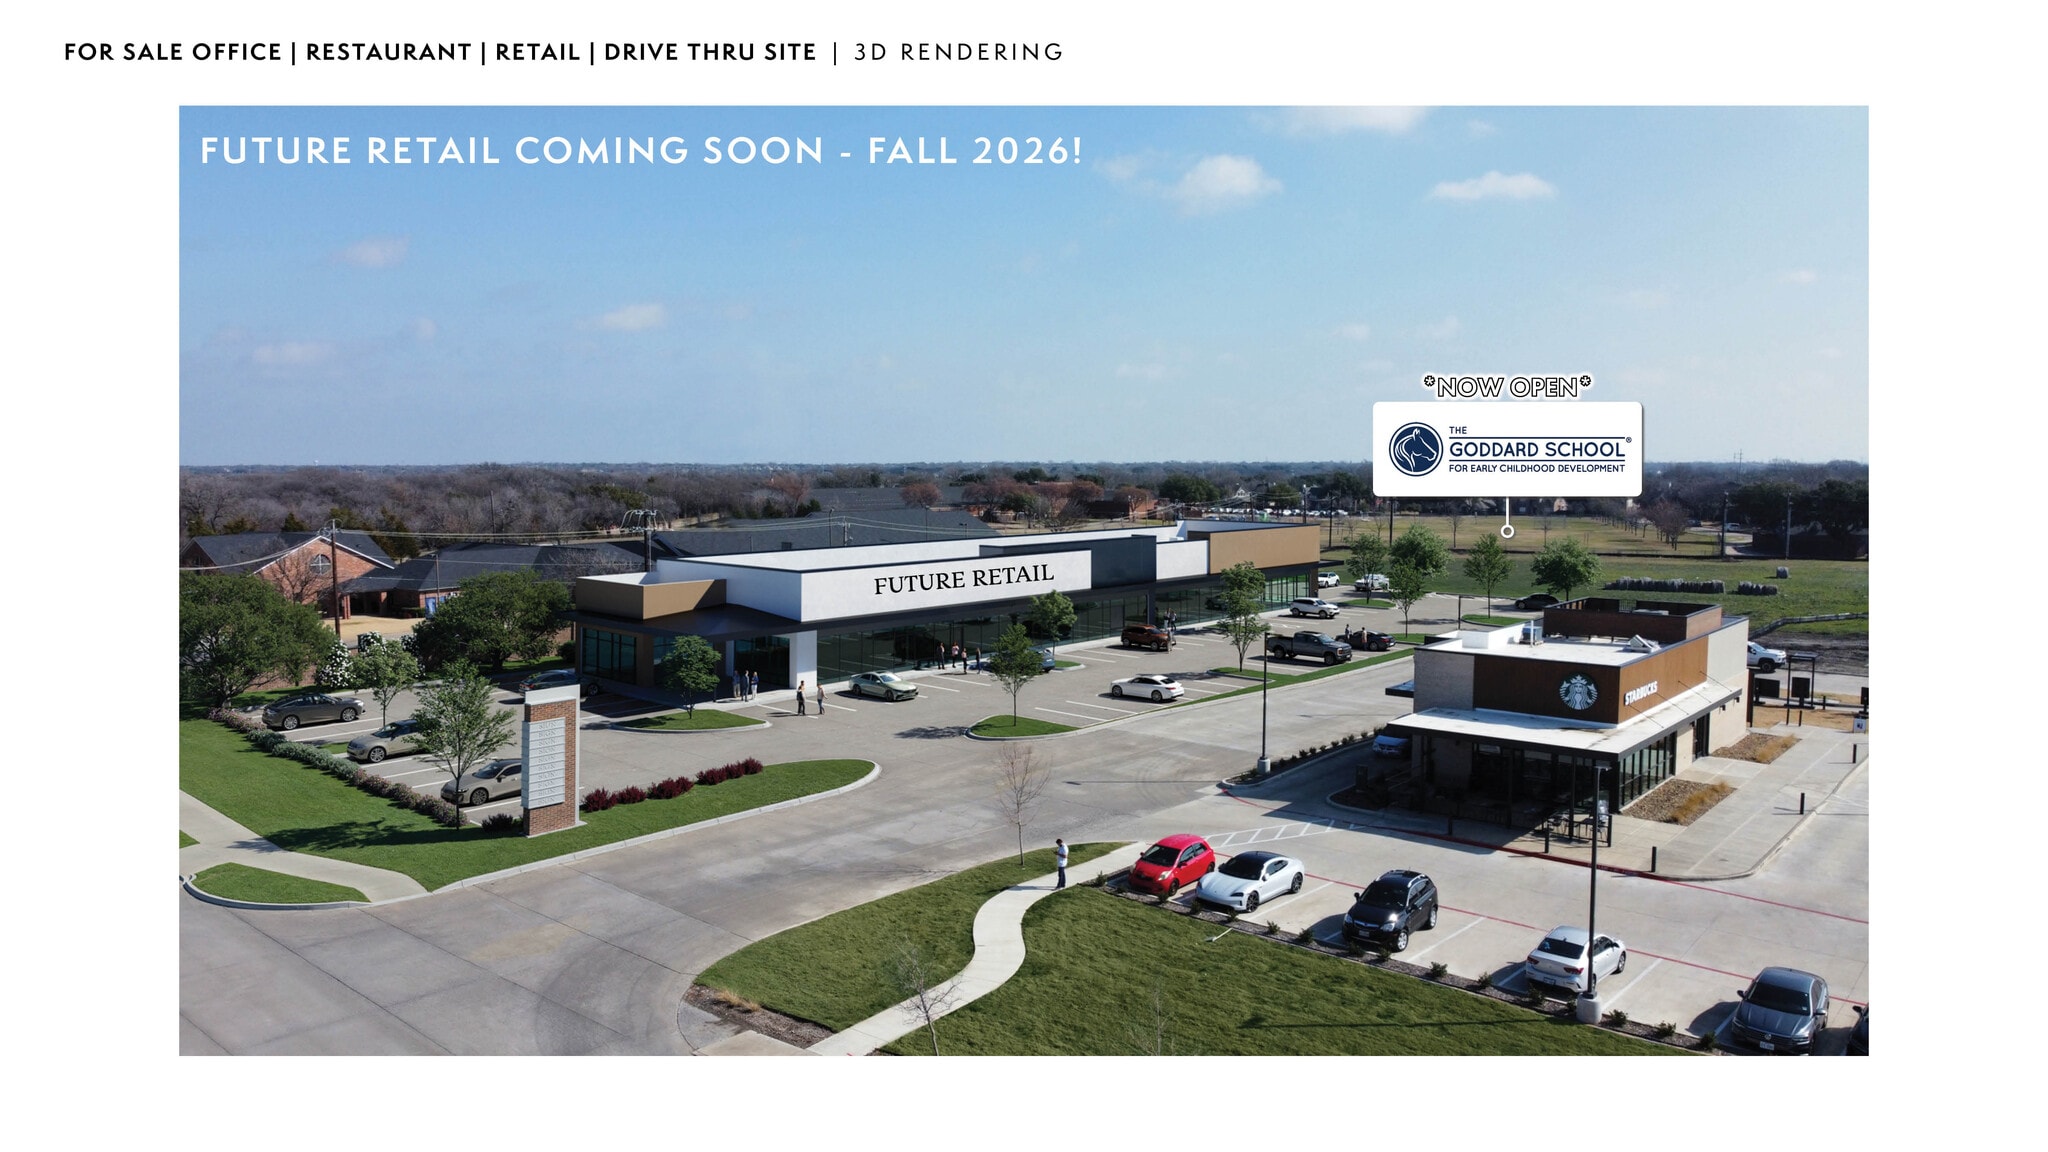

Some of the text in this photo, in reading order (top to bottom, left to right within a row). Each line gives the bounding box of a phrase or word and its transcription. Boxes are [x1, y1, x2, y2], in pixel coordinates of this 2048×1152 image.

[874, 563, 1055, 595] FUTURE RETAIL
[1624, 680, 1658, 706] STARBUCKS
